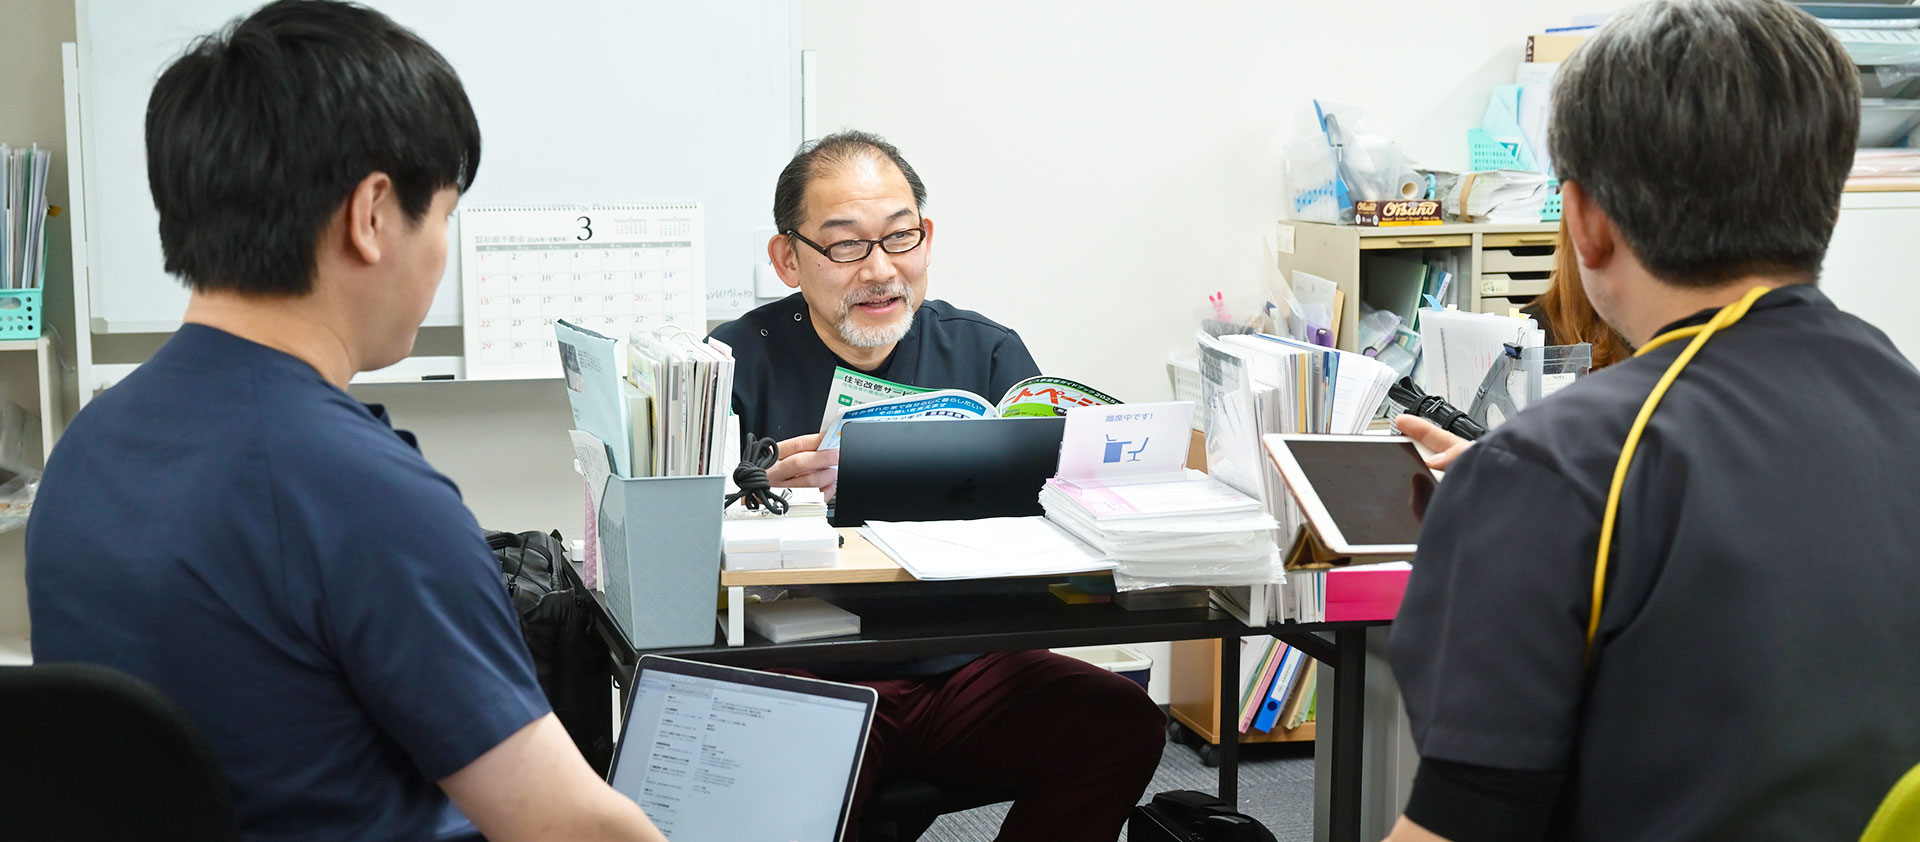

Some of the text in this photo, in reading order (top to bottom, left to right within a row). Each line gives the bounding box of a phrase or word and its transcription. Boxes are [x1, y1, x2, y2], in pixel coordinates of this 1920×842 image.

[577, 216, 592, 240] 3
[603, 273, 614, 281] 12
[633, 272, 644, 280] 13
[542, 296, 552, 304] 17
[663, 293, 673, 301] 21
[634, 316, 644, 324] 27
[664, 315, 675, 323] 28
[844, 375, 918, 396] 住宅改修サービ
